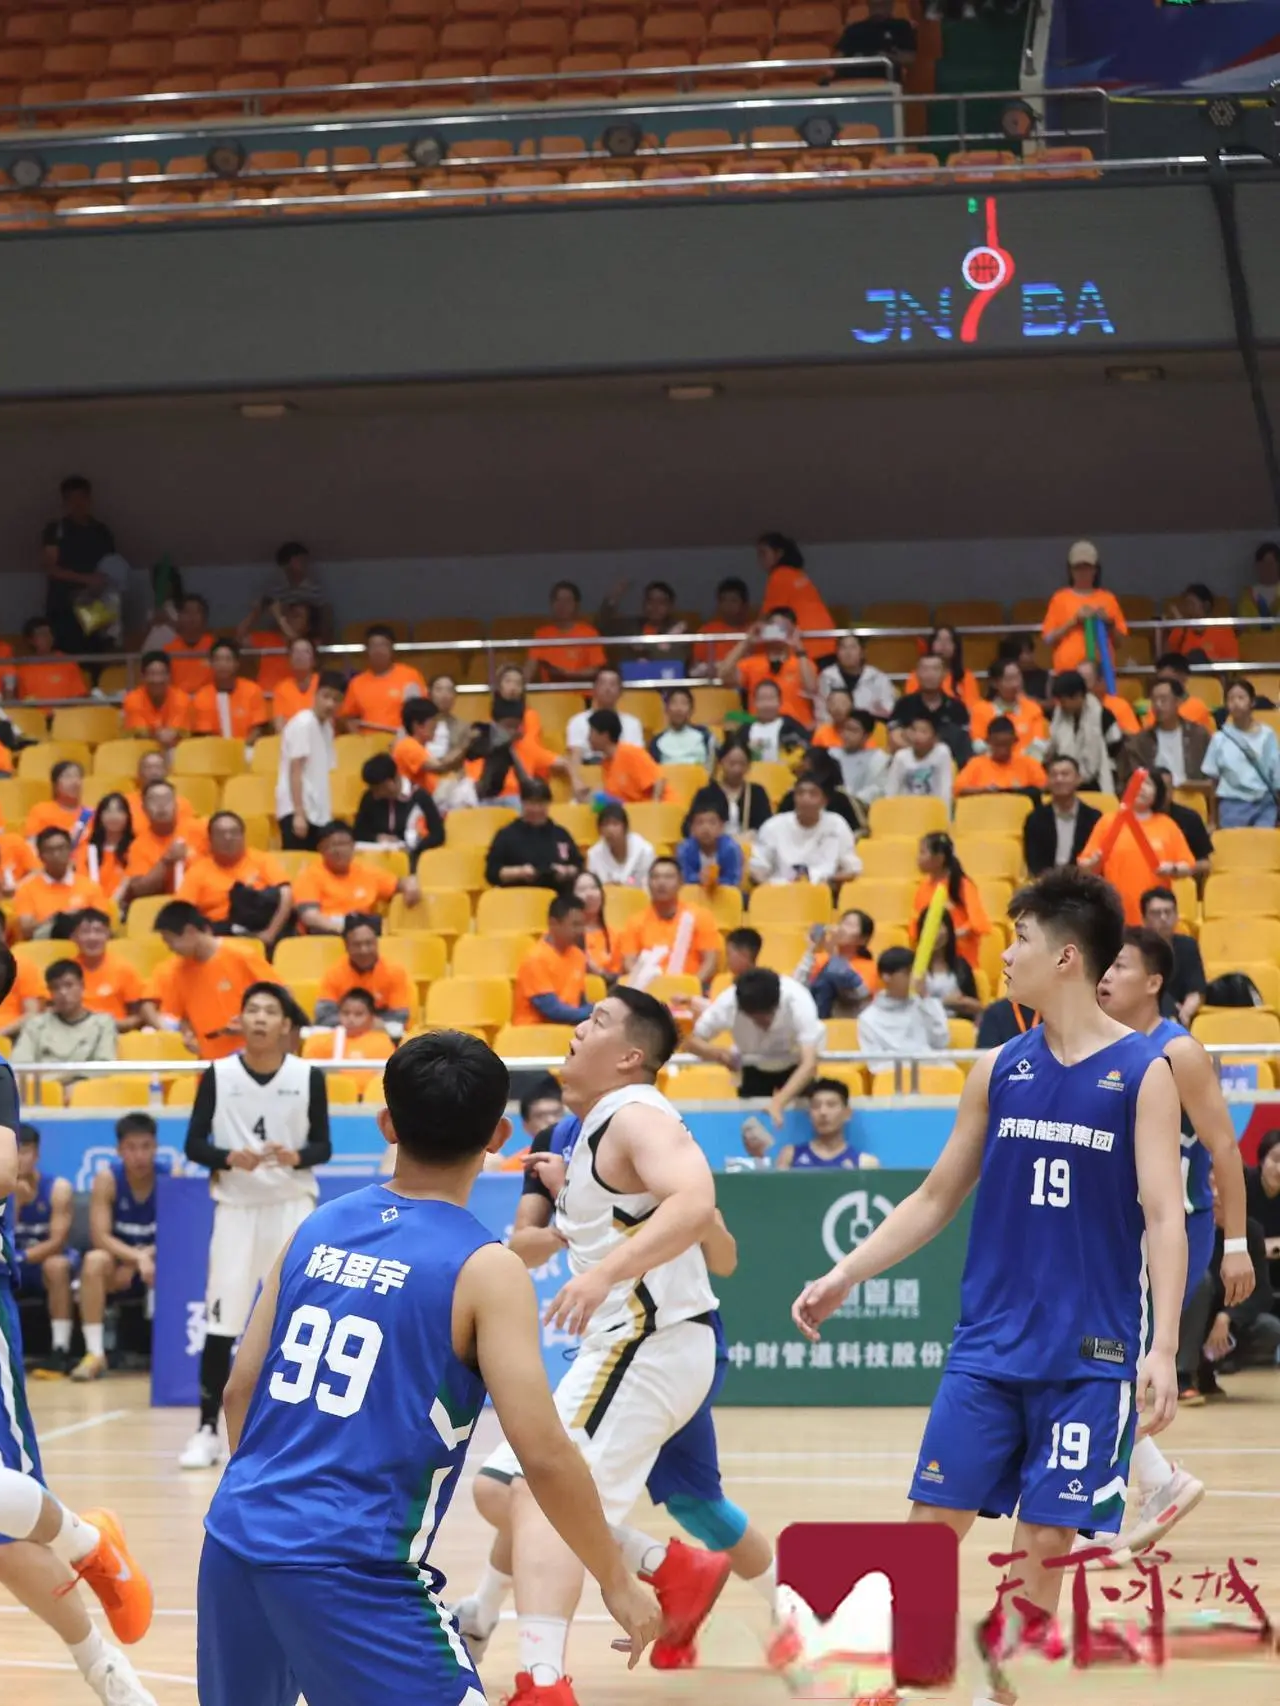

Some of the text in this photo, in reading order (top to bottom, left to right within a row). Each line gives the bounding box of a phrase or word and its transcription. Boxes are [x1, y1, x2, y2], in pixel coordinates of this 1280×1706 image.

[253, 1115, 267, 1141] 4
[998, 1117, 1115, 1152] 济南能源集团
[1030, 1157, 1070, 1208] 19
[304, 1243, 412, 1295] 杨思宇
[269, 1304, 384, 1418] 99
[727, 1341, 953, 1369] 中财管道科技股份
[1046, 1422, 1090, 1470] 19
